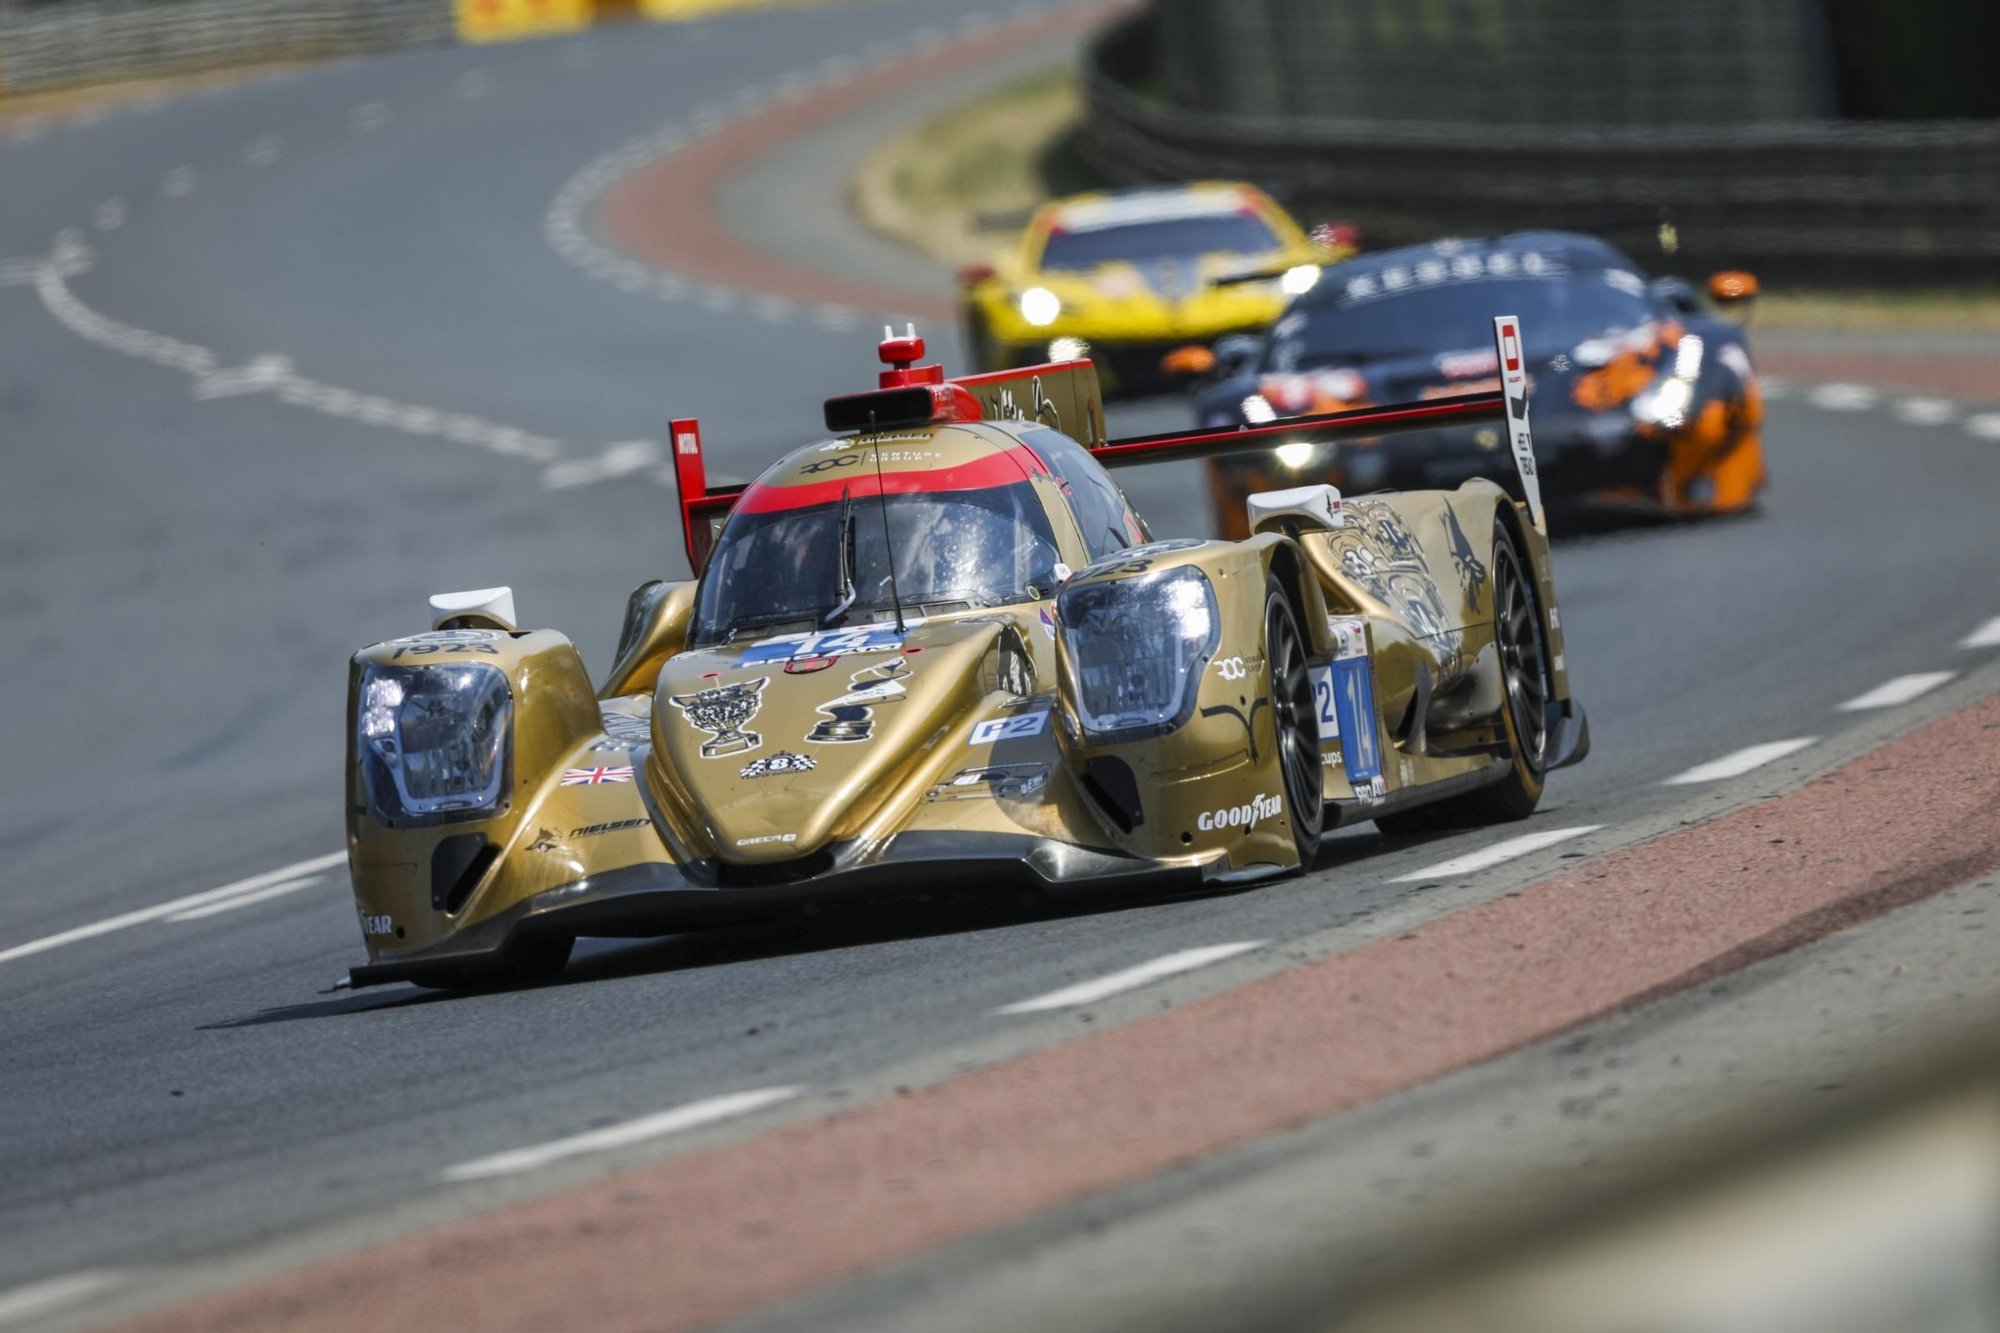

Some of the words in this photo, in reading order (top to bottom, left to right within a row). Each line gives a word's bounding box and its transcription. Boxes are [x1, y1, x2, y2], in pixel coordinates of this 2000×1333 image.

[392, 642, 499, 660] 1923
[790, 631, 872, 655] 14
[1213, 656, 1246, 681] ROC
[981, 716, 1039, 738] P2
[1346, 665, 1374, 769] 14
[1197, 793, 1282, 831] GOODYEAR
[569, 818, 653, 837] NIELSEN
